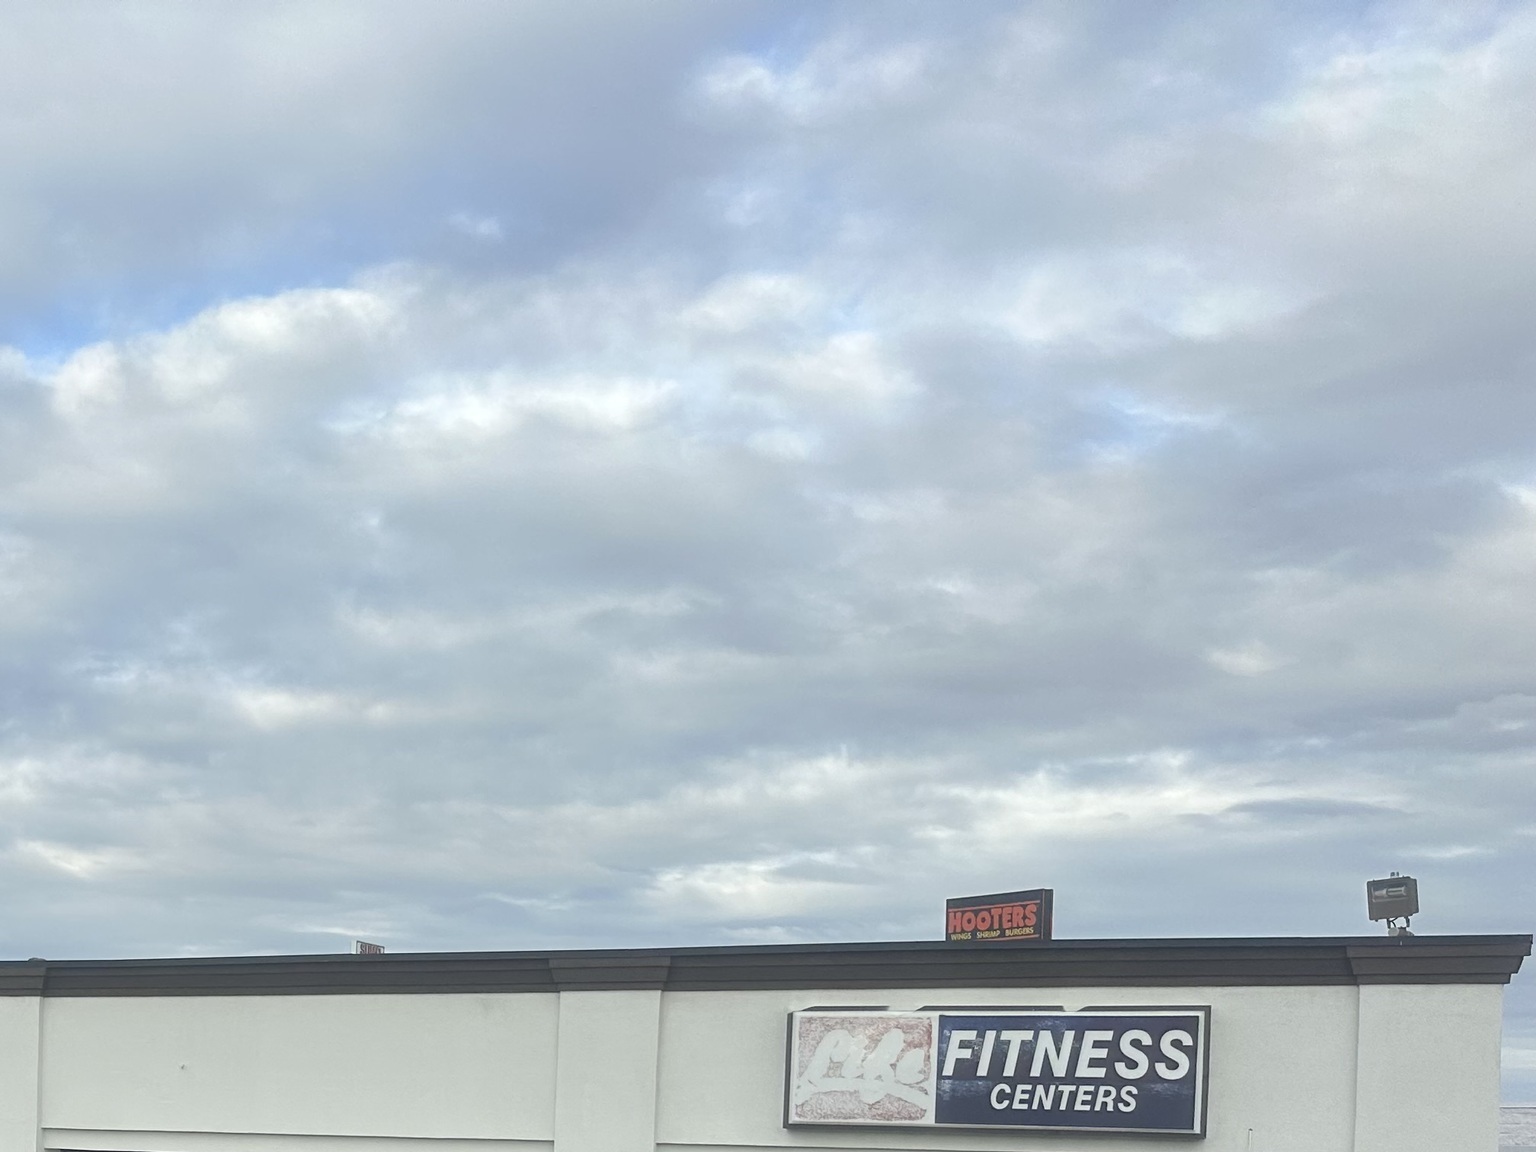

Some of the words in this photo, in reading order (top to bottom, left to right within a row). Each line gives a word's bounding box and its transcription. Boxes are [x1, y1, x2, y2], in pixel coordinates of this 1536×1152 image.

[948, 904, 1037, 934] HOOTERS
[950, 932, 972, 941] WINGS
[976, 930, 1001, 939] SHRIMP
[1005, 927, 1034, 937] BURGERS
[941, 1029, 1194, 1080] FITNESS
[989, 1083, 1139, 1114] CENTERS
